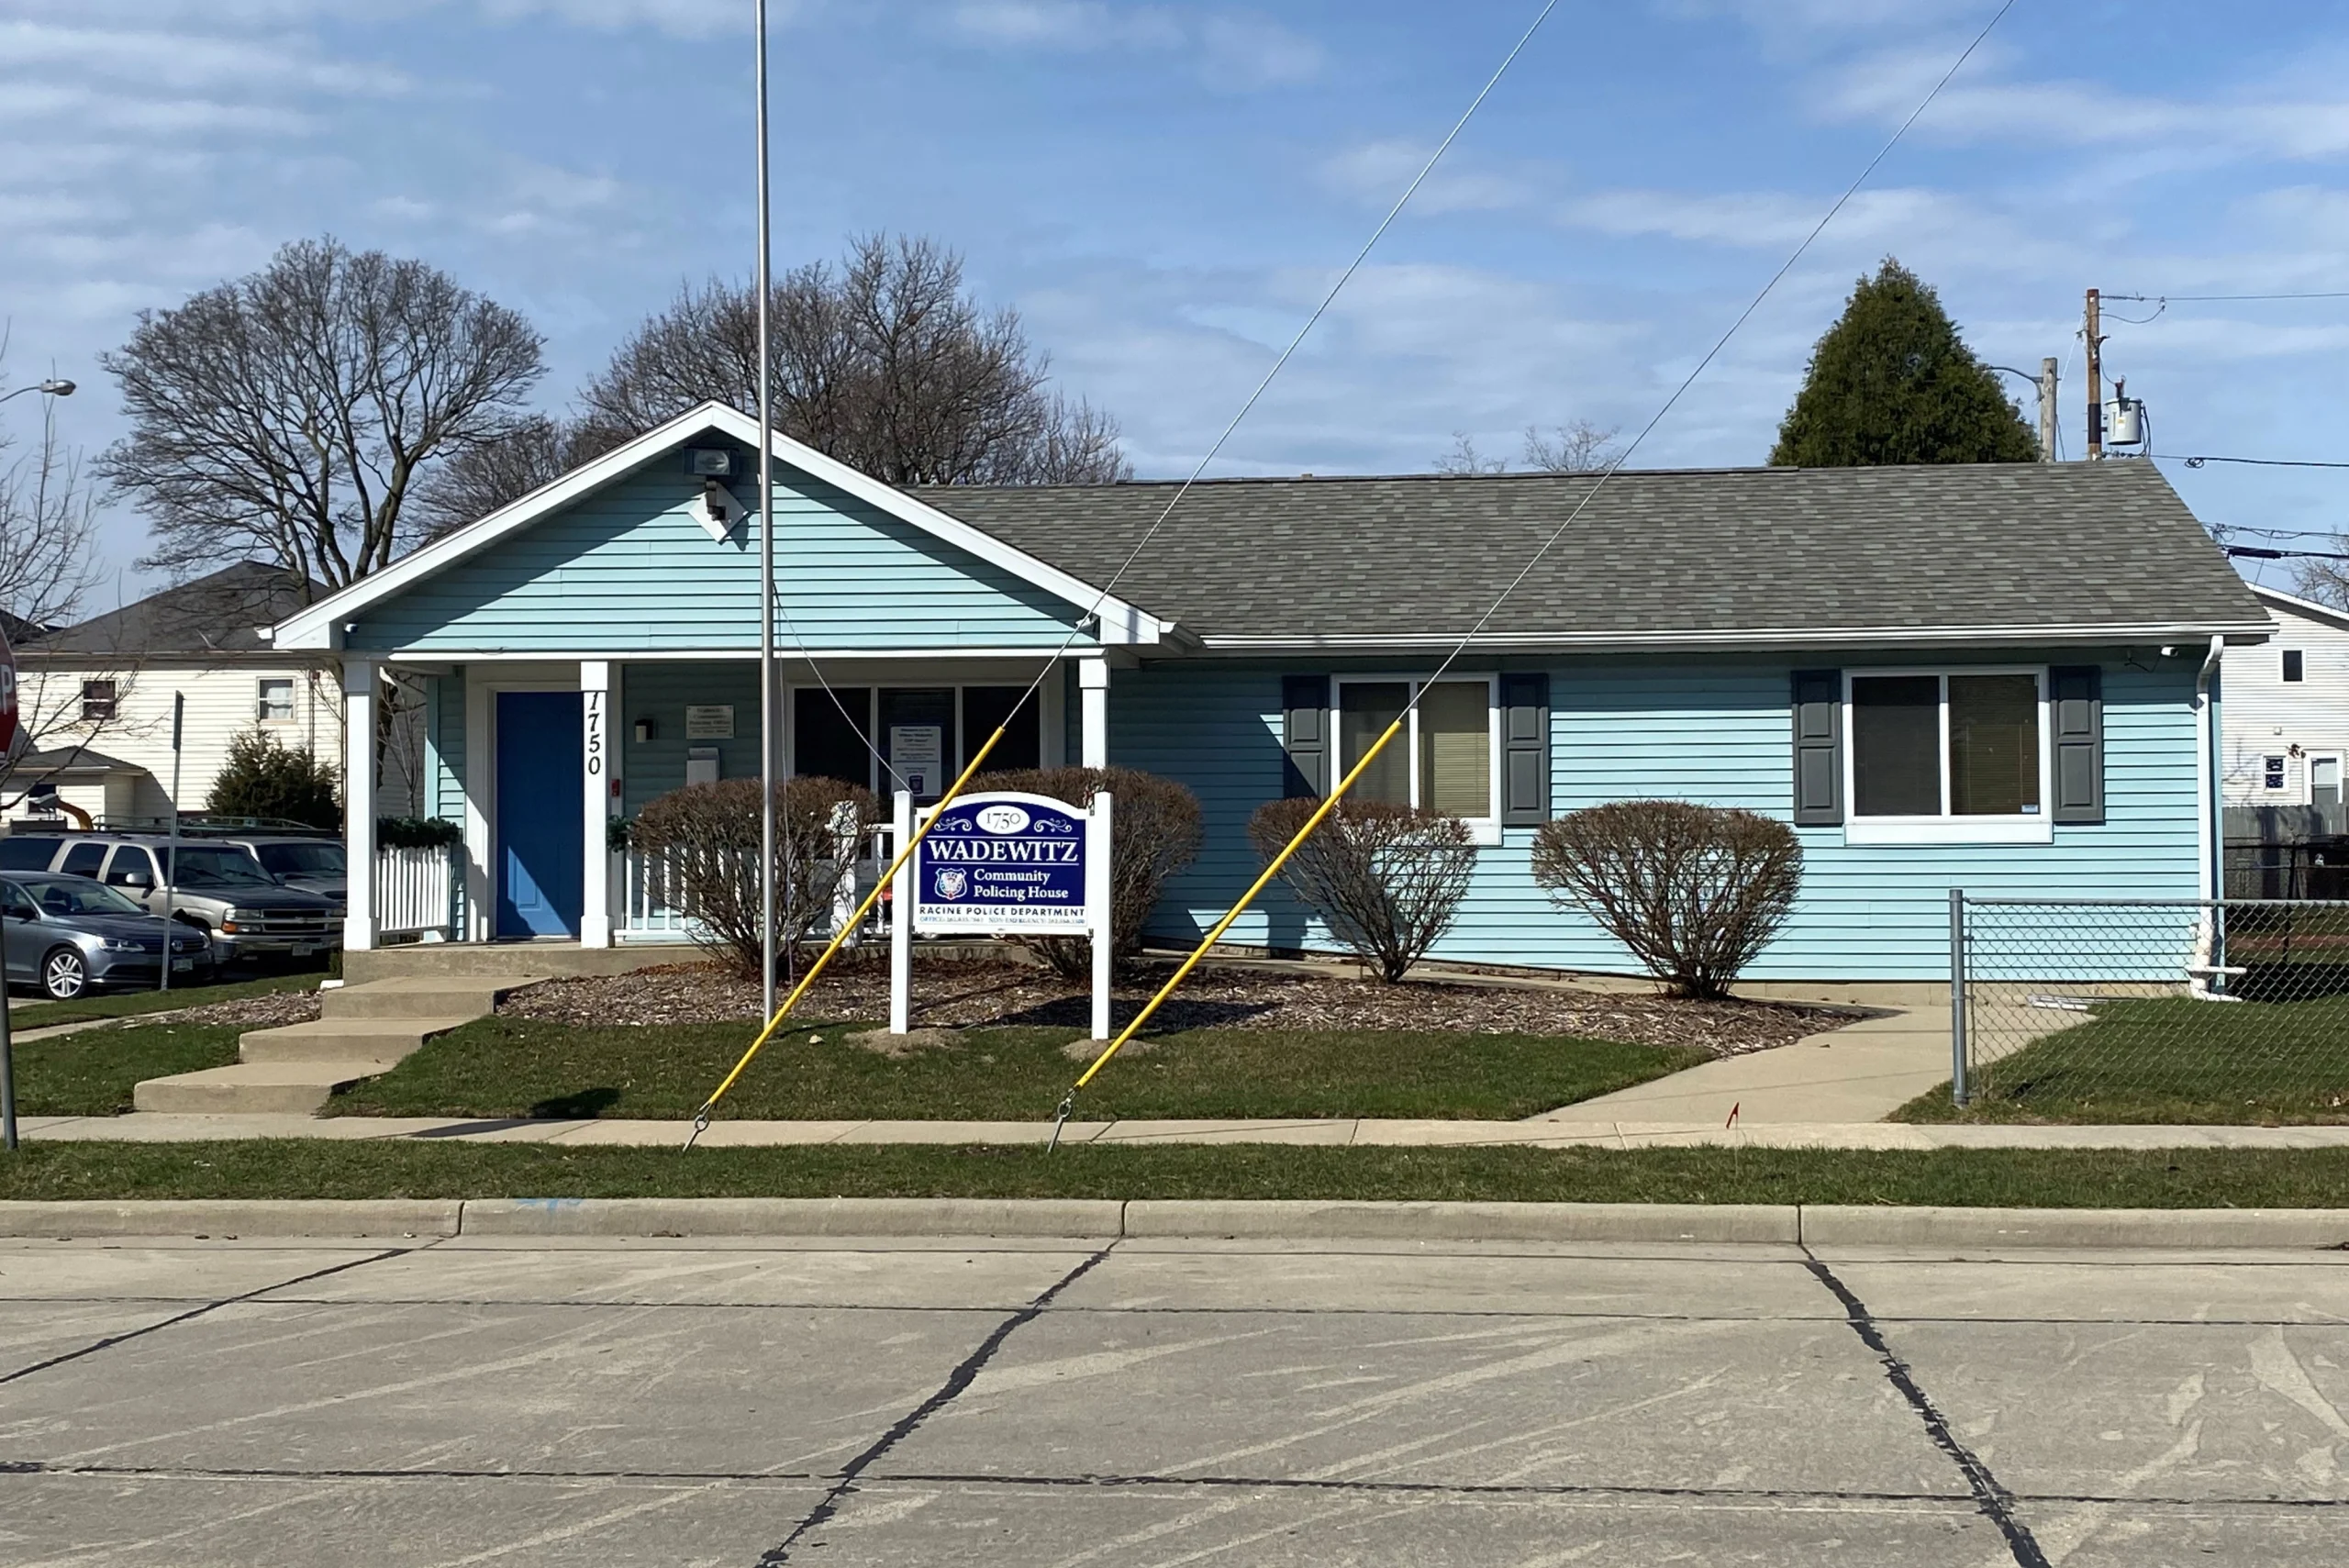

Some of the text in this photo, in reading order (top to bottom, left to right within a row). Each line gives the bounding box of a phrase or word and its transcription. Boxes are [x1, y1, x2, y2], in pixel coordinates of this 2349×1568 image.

[587, 692, 601, 775] 1750
[985, 813, 1021, 830] 1750
[928, 840, 1078, 862] WADEWITZ
[974, 869, 1052, 885] Community
[974, 884, 1069, 902] Policing House
[919, 906, 1085, 917] RACINE POLICE DEPARTMENT
